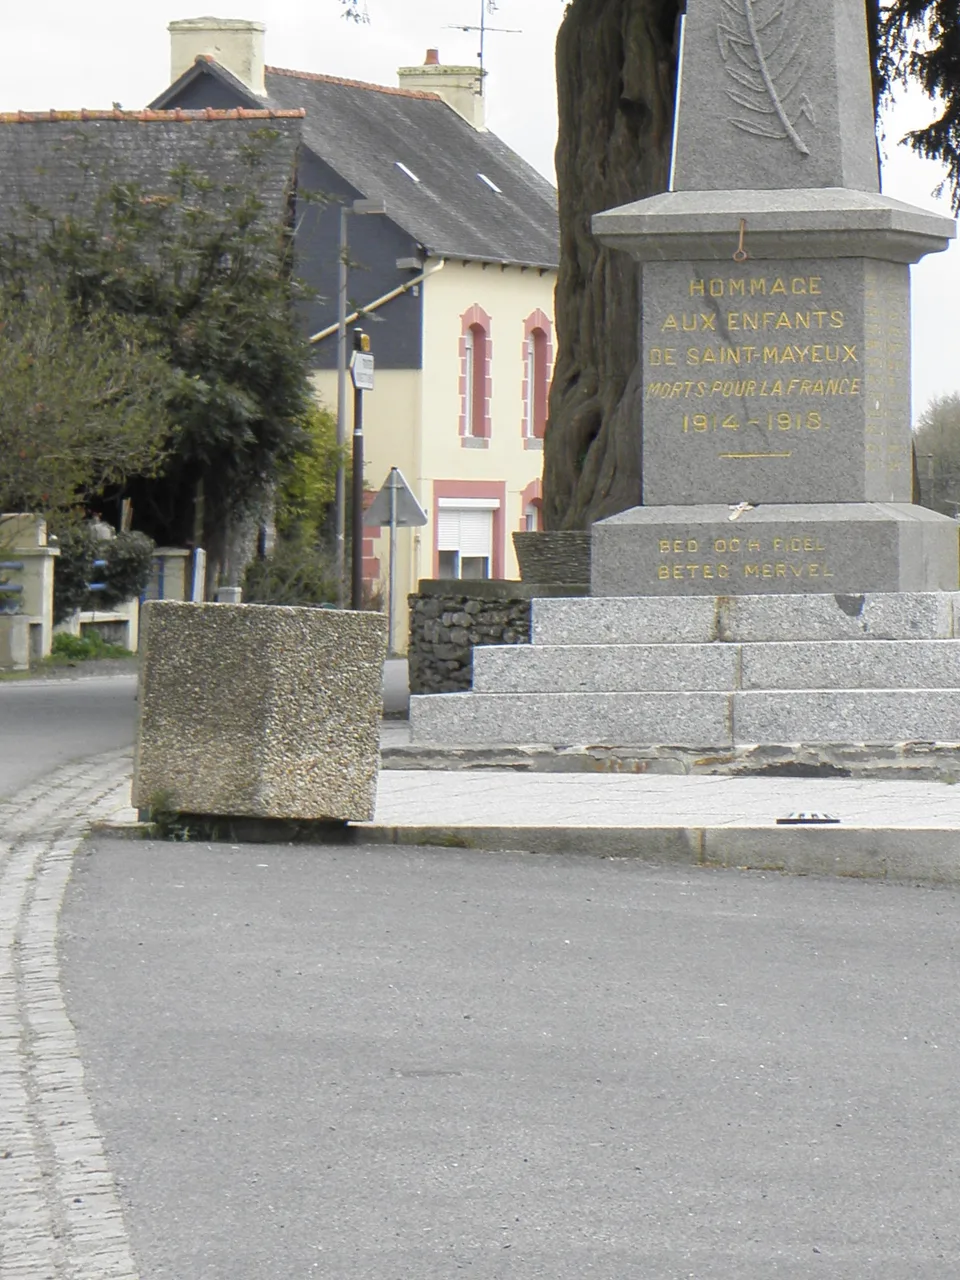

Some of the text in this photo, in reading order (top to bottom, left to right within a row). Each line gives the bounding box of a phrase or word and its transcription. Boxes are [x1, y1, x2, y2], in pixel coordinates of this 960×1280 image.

[688, 276, 823, 298] HOMMAGE
[661, 310, 845, 331] AUX ENFANTS
[649, 344, 859, 366] DE SAINT-MAYEUX
[646, 378, 861, 399] MORTS POUR LA FRANCE
[659, 539, 699, 553] BED
[773, 538, 827, 552] FIDEL
[744, 563, 835, 579] MERVEL
